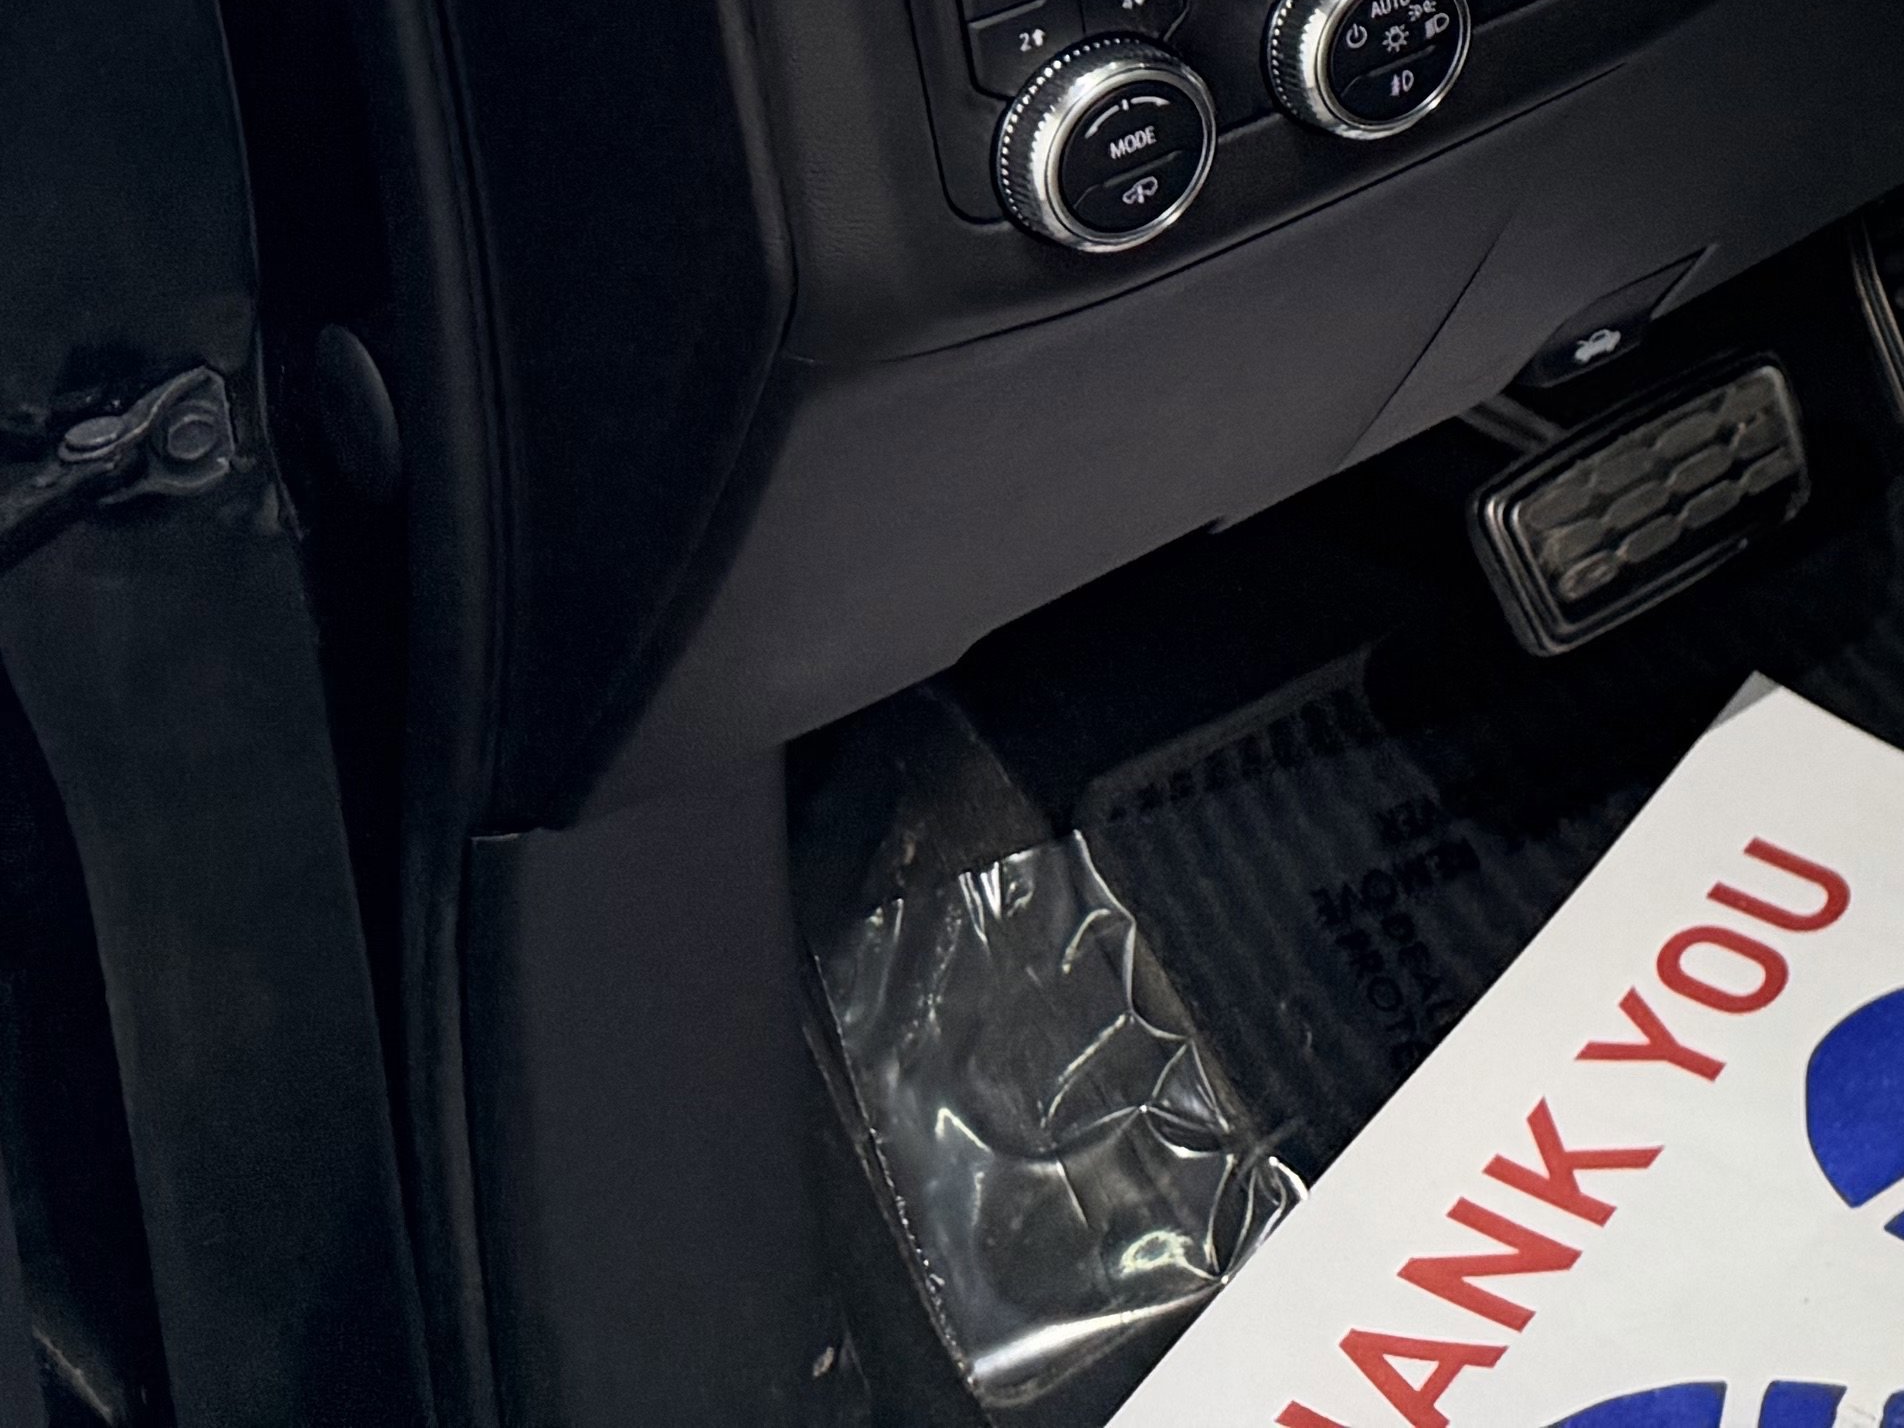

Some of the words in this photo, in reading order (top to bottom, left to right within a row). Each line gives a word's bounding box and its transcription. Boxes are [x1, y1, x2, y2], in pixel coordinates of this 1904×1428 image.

[1109, 125, 1157, 160] MODE
[1275, 1098, 1664, 1428] ANK
[1575, 836, 1852, 1082] YOU
